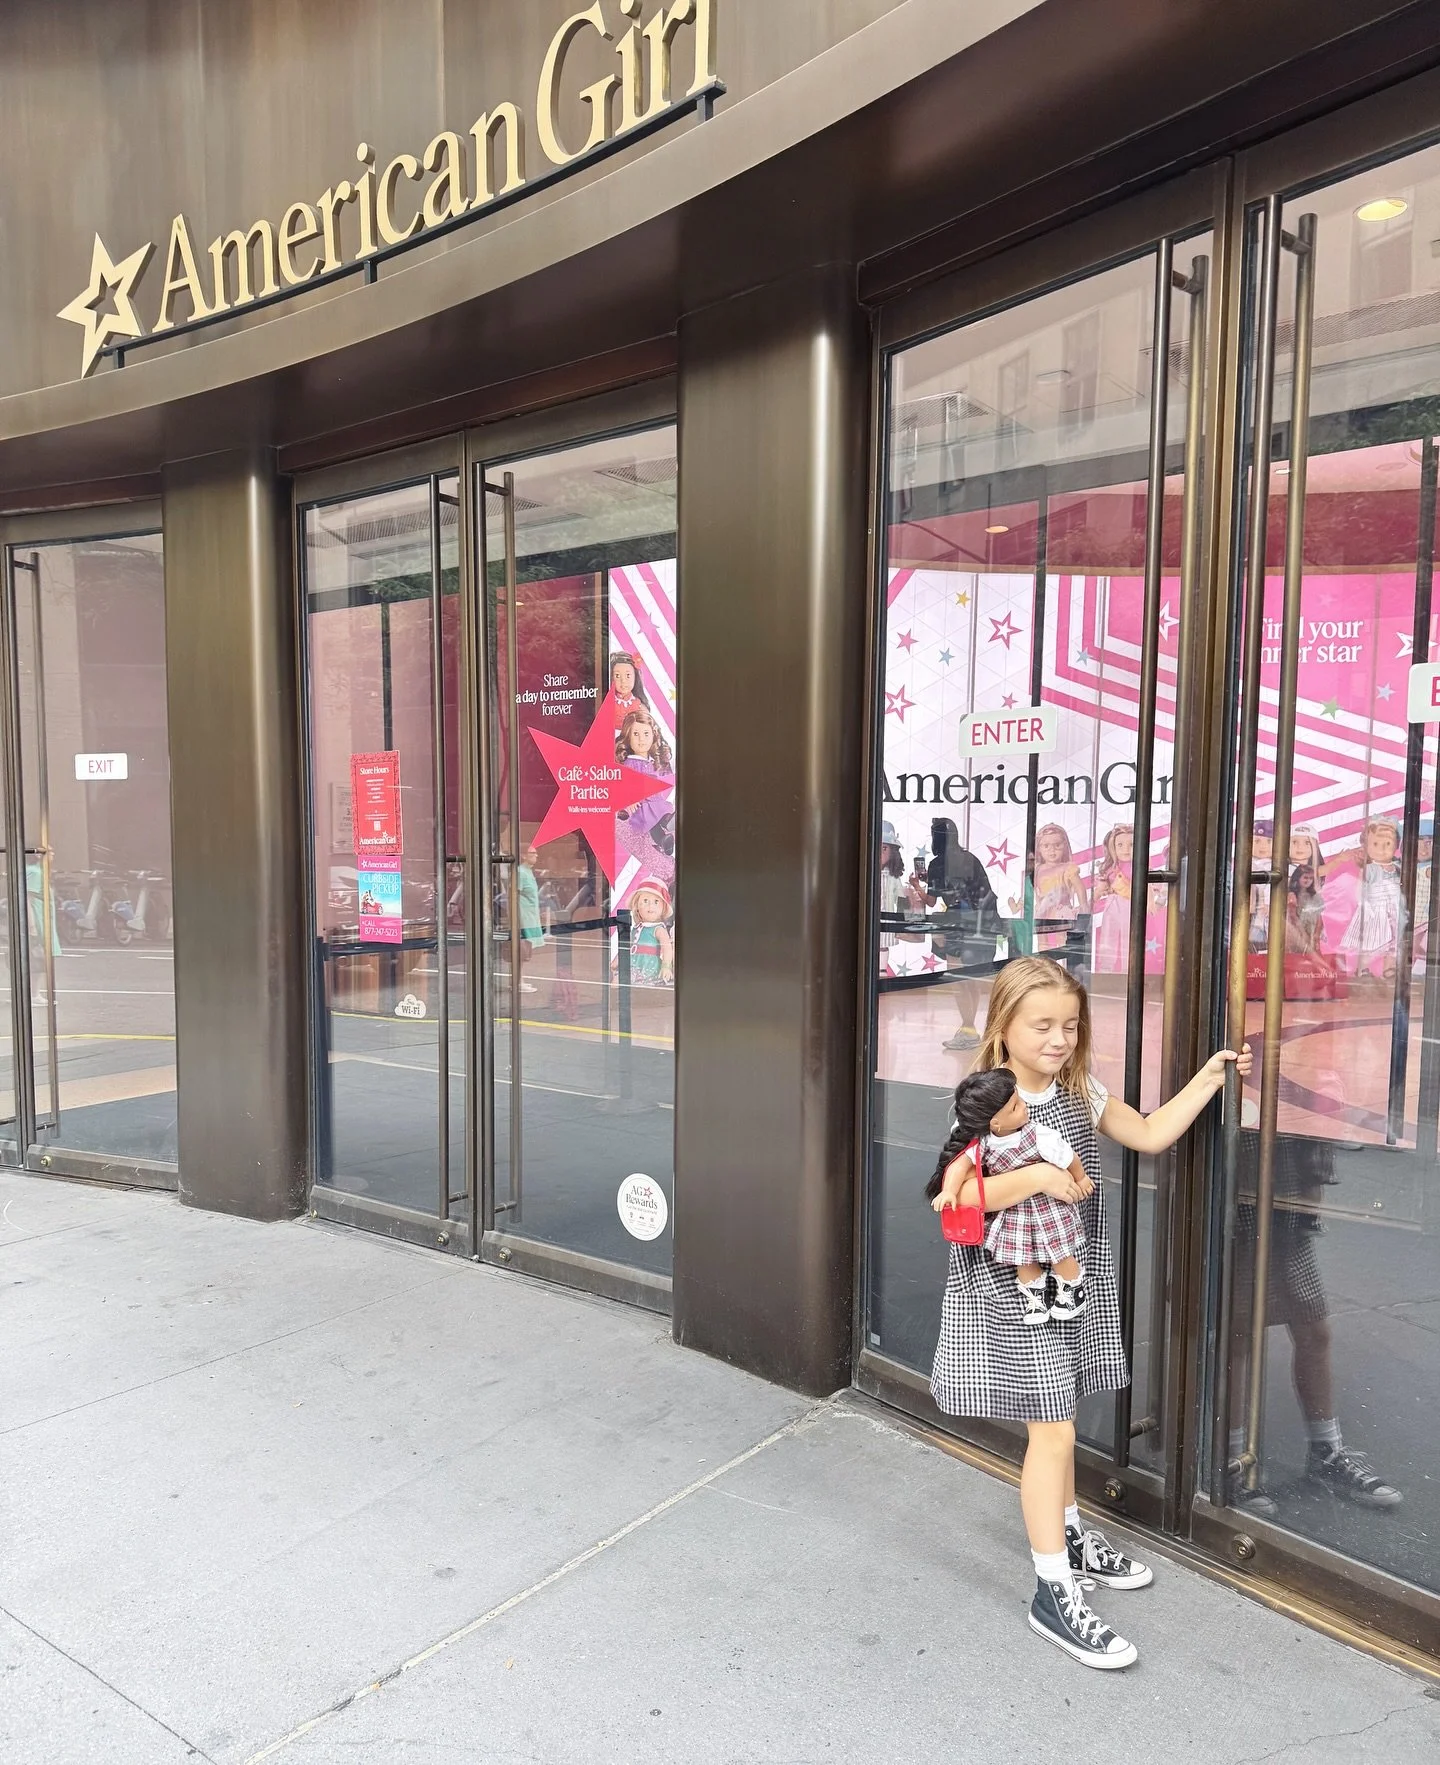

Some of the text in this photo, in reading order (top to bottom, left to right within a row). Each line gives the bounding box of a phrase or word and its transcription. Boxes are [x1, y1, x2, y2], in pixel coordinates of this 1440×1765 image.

[152, 0, 719, 334] American Girl
[1308, 620, 1364, 644] your
[1316, 641, 1363, 663] star
[543, 673, 569, 687] Share
[515, 685, 599, 705] a day to remember
[542, 703, 573, 716] forever
[971, 717, 1045, 746] ENTER
[88, 759, 115, 774] EXIT
[360, 766, 390, 775] Store Hours
[558, 764, 622, 782] Café Salon
[570, 784, 609, 800] Parties
[359, 836, 397, 845] American Girl
[368, 861, 398, 869] American Girl
[363, 873, 399, 884] CURBSIDE
[372, 883, 399, 895] PICKUP
[401, 1005, 420, 1015] Wi-Fi
[630, 1185, 643, 1196] AG
[625, 1193, 658, 1210] Rewards
